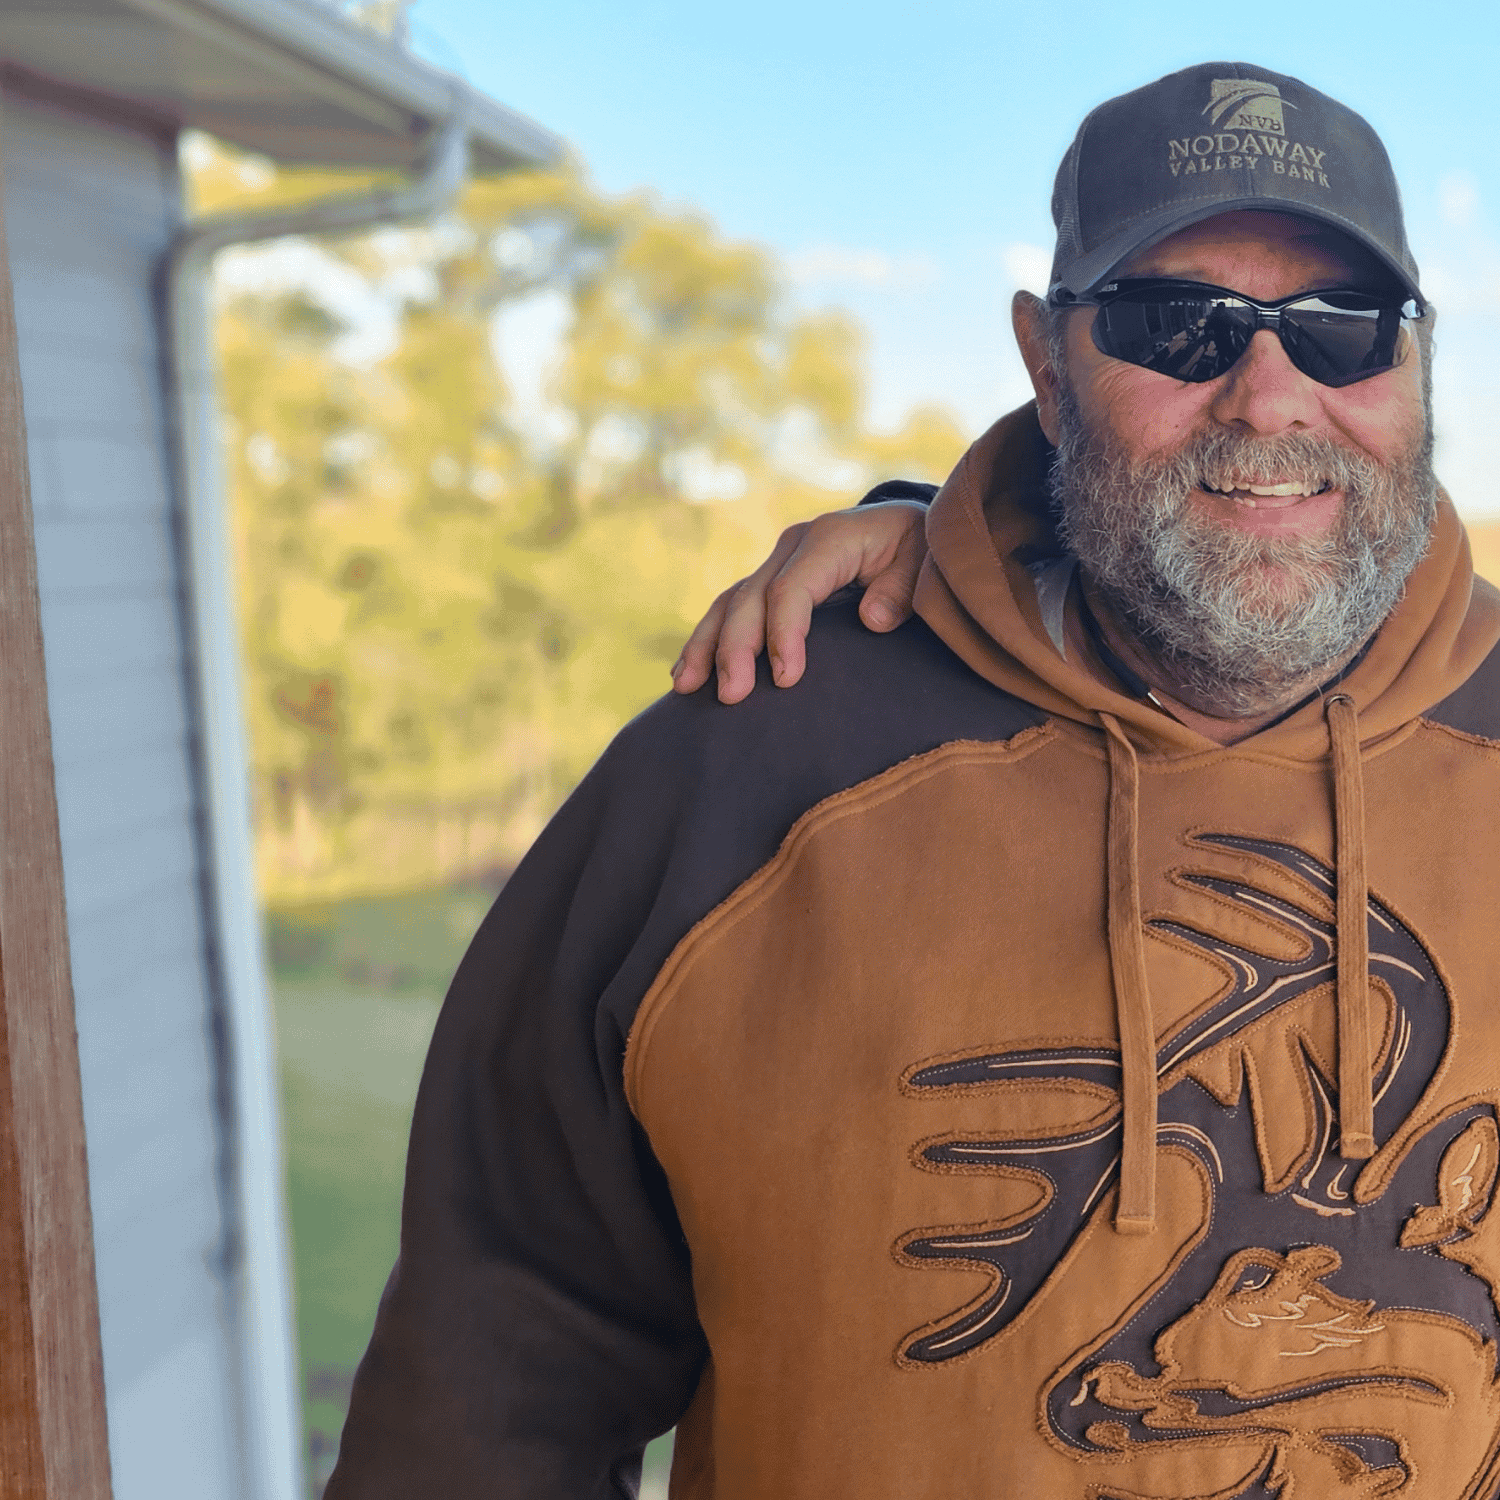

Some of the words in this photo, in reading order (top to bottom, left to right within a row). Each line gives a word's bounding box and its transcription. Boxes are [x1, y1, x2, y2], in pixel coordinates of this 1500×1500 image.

[1168, 132, 1327, 170] NODAWAY
[1168, 155, 1259, 178] VALLEY
[1272, 159, 1332, 189] BANK
